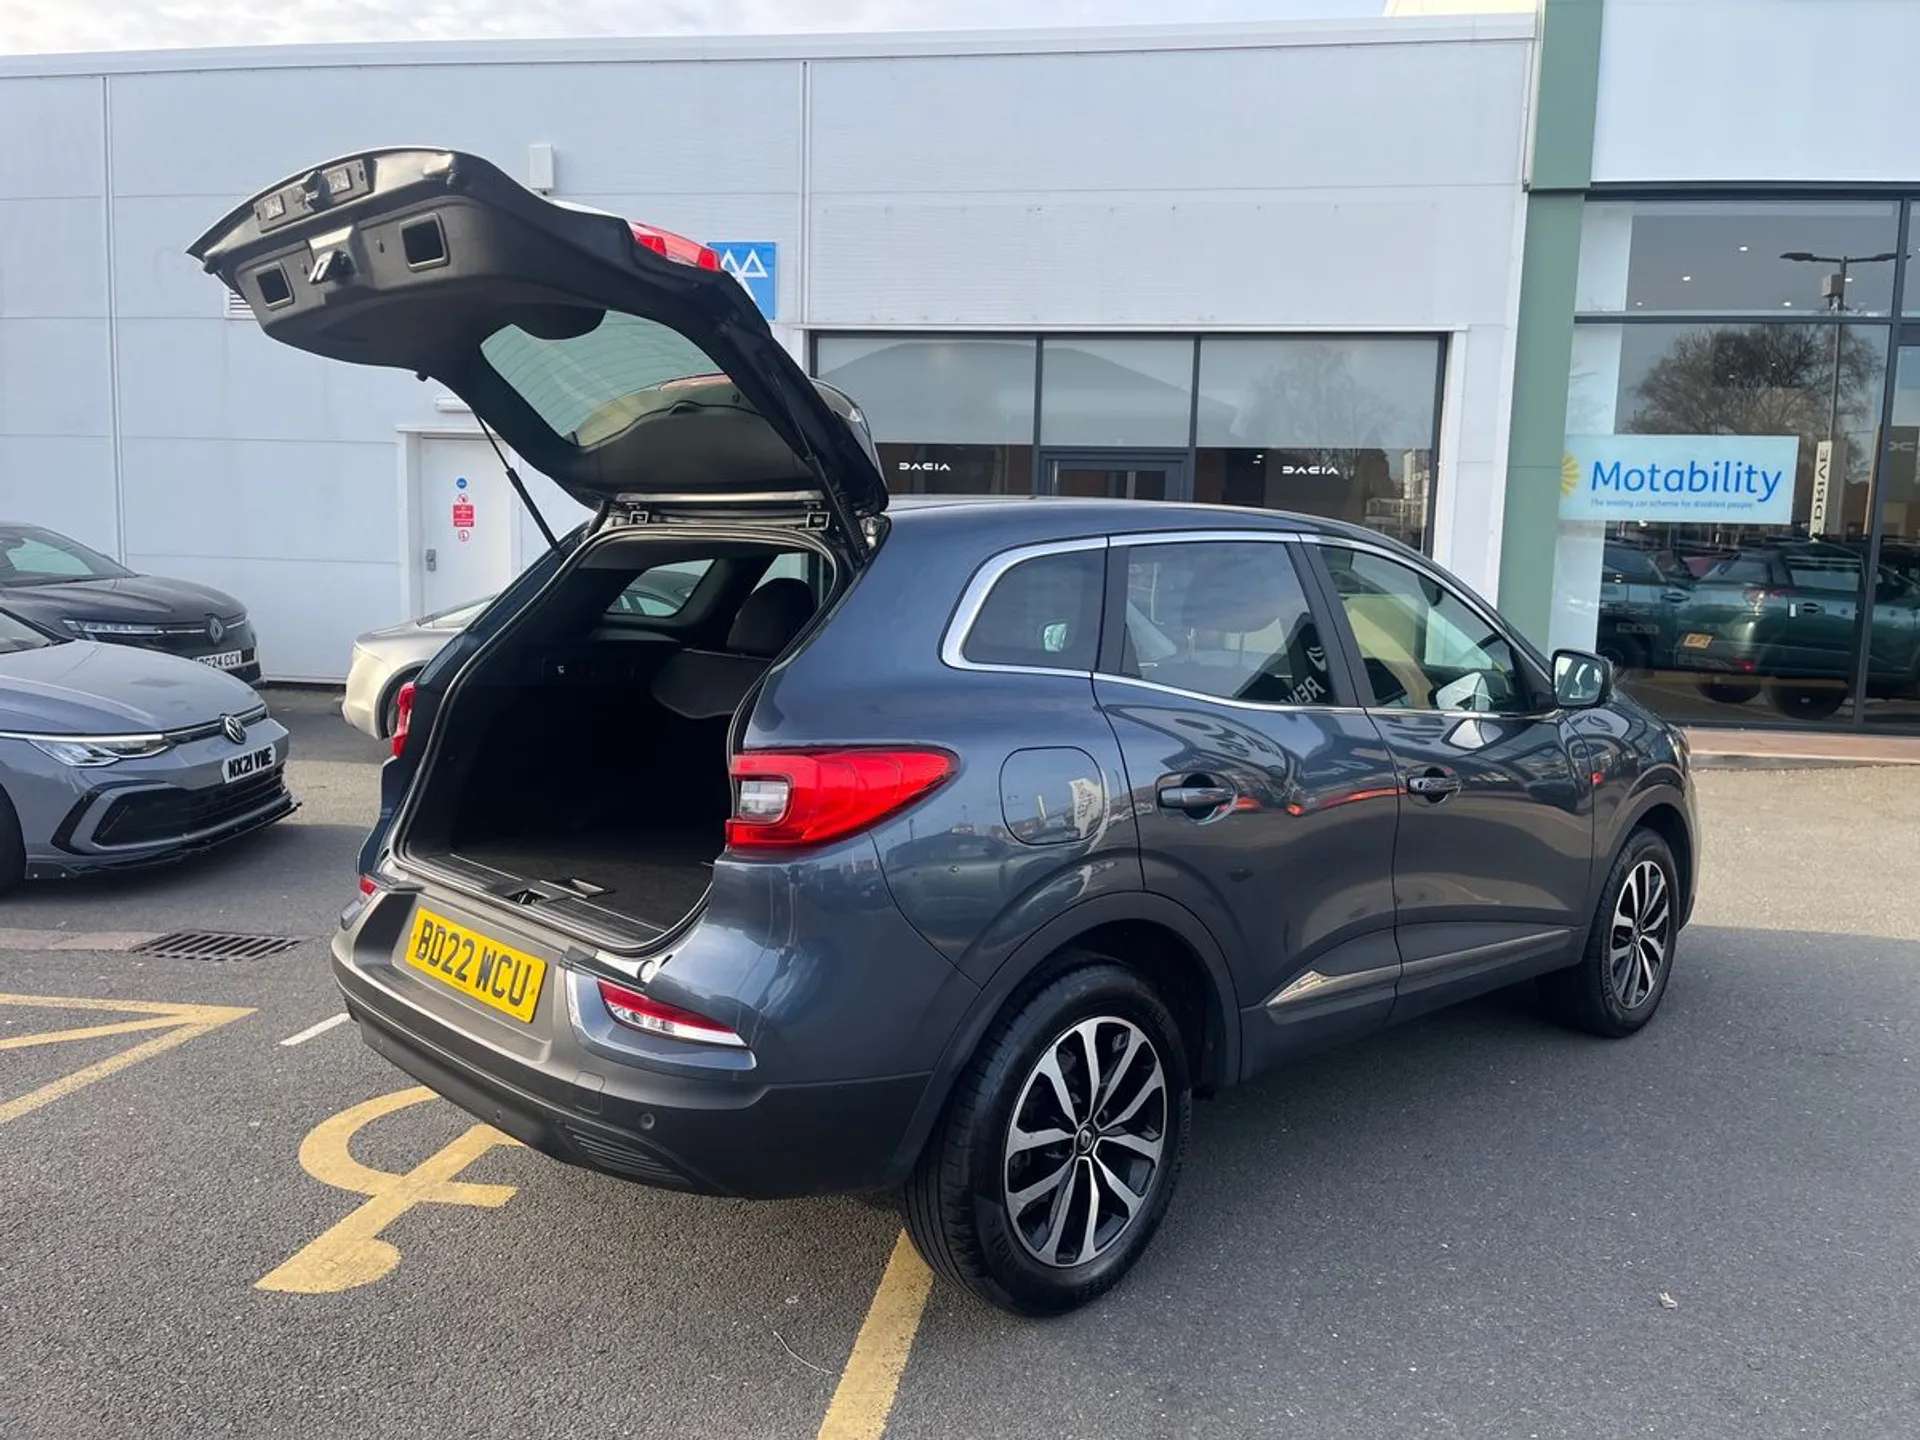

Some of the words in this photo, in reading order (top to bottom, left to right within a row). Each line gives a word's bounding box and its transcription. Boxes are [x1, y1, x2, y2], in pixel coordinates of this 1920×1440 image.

[898, 462, 951, 471] DACIA
[1281, 465, 1340, 475] DACIA
[1591, 460, 1783, 503] Motability
[416, 919, 475, 983] BD22
[475, 945, 532, 1007] WCU
